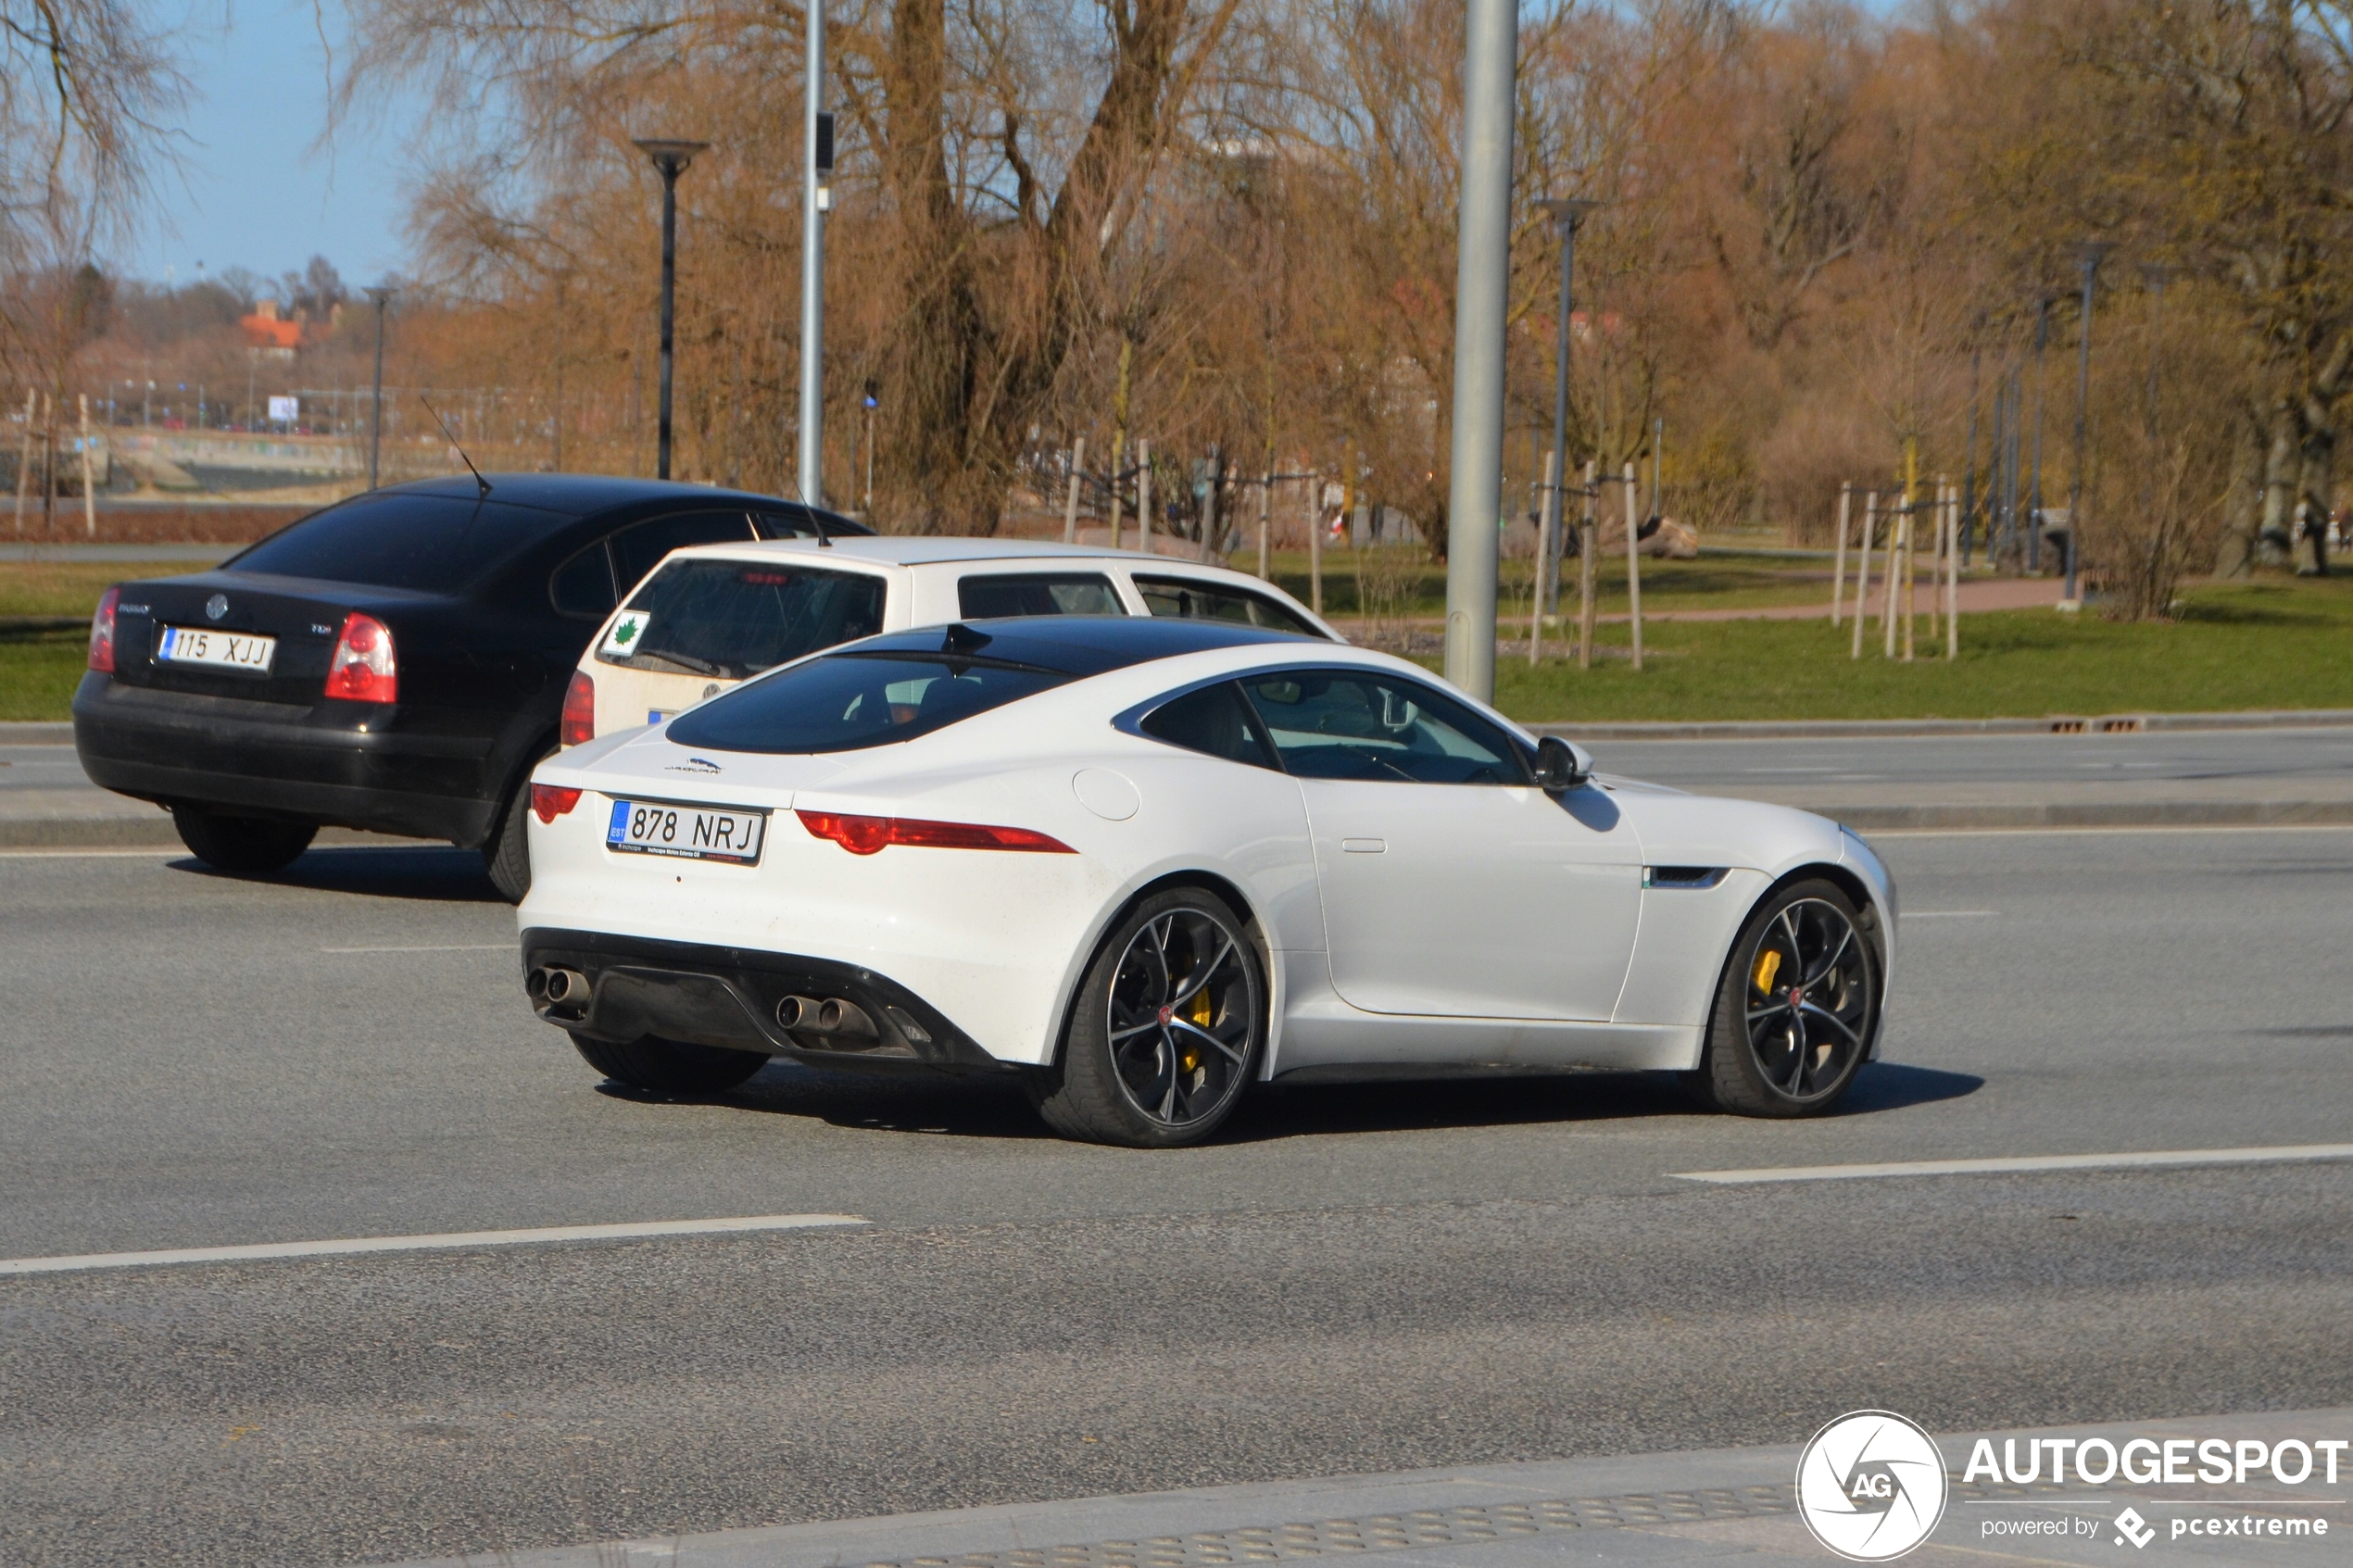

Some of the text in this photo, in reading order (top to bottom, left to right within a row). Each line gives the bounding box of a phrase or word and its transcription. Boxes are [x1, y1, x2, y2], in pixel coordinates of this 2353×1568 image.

[176, 633, 267, 664] 115 XJJ
[610, 827, 625, 837] EST
[632, 809, 753, 850] 878 NRJ
